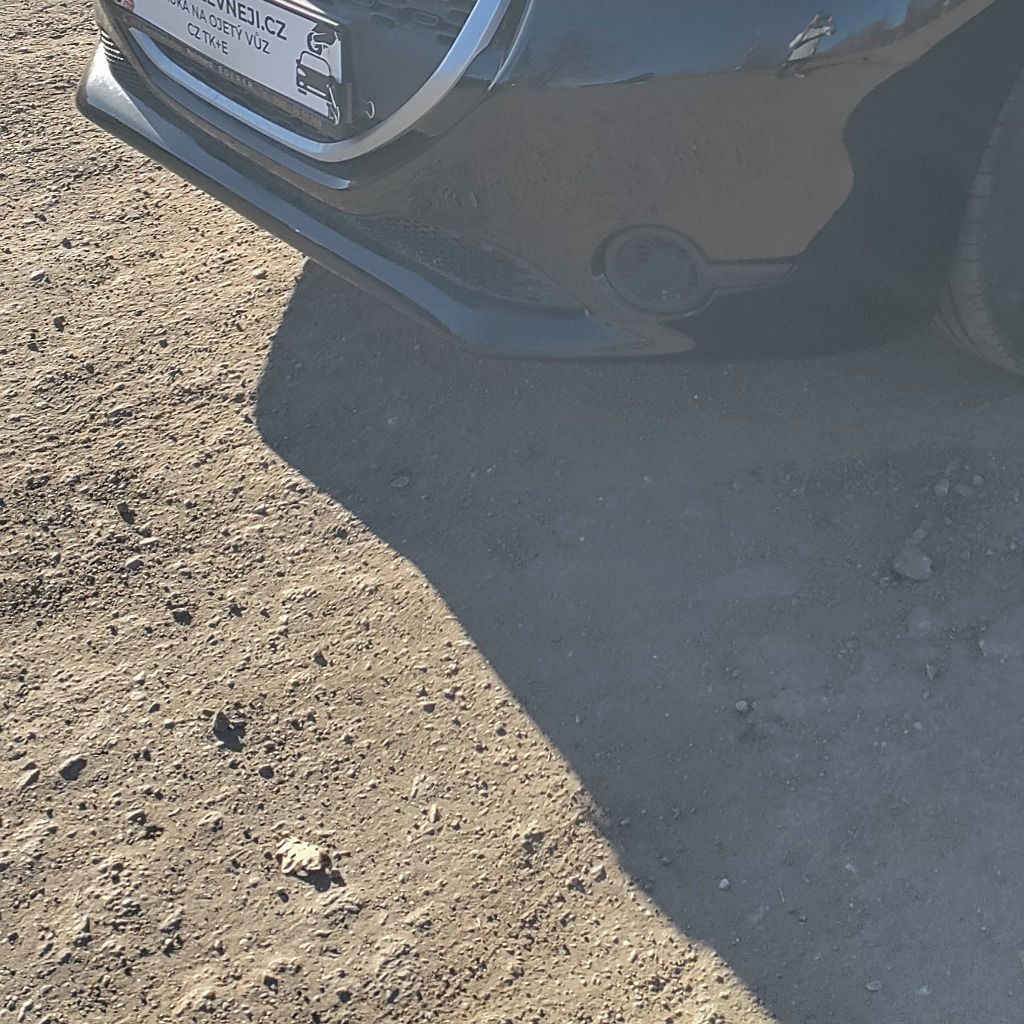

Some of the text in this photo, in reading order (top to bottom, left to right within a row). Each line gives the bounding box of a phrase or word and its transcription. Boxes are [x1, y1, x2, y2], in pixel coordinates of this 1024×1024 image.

[187, 22, 201, 39] CZ
[192, 6, 207, 21] NA
[209, 14, 243, 41] OJETÝ
[245, 30, 271, 54] VŮZ
